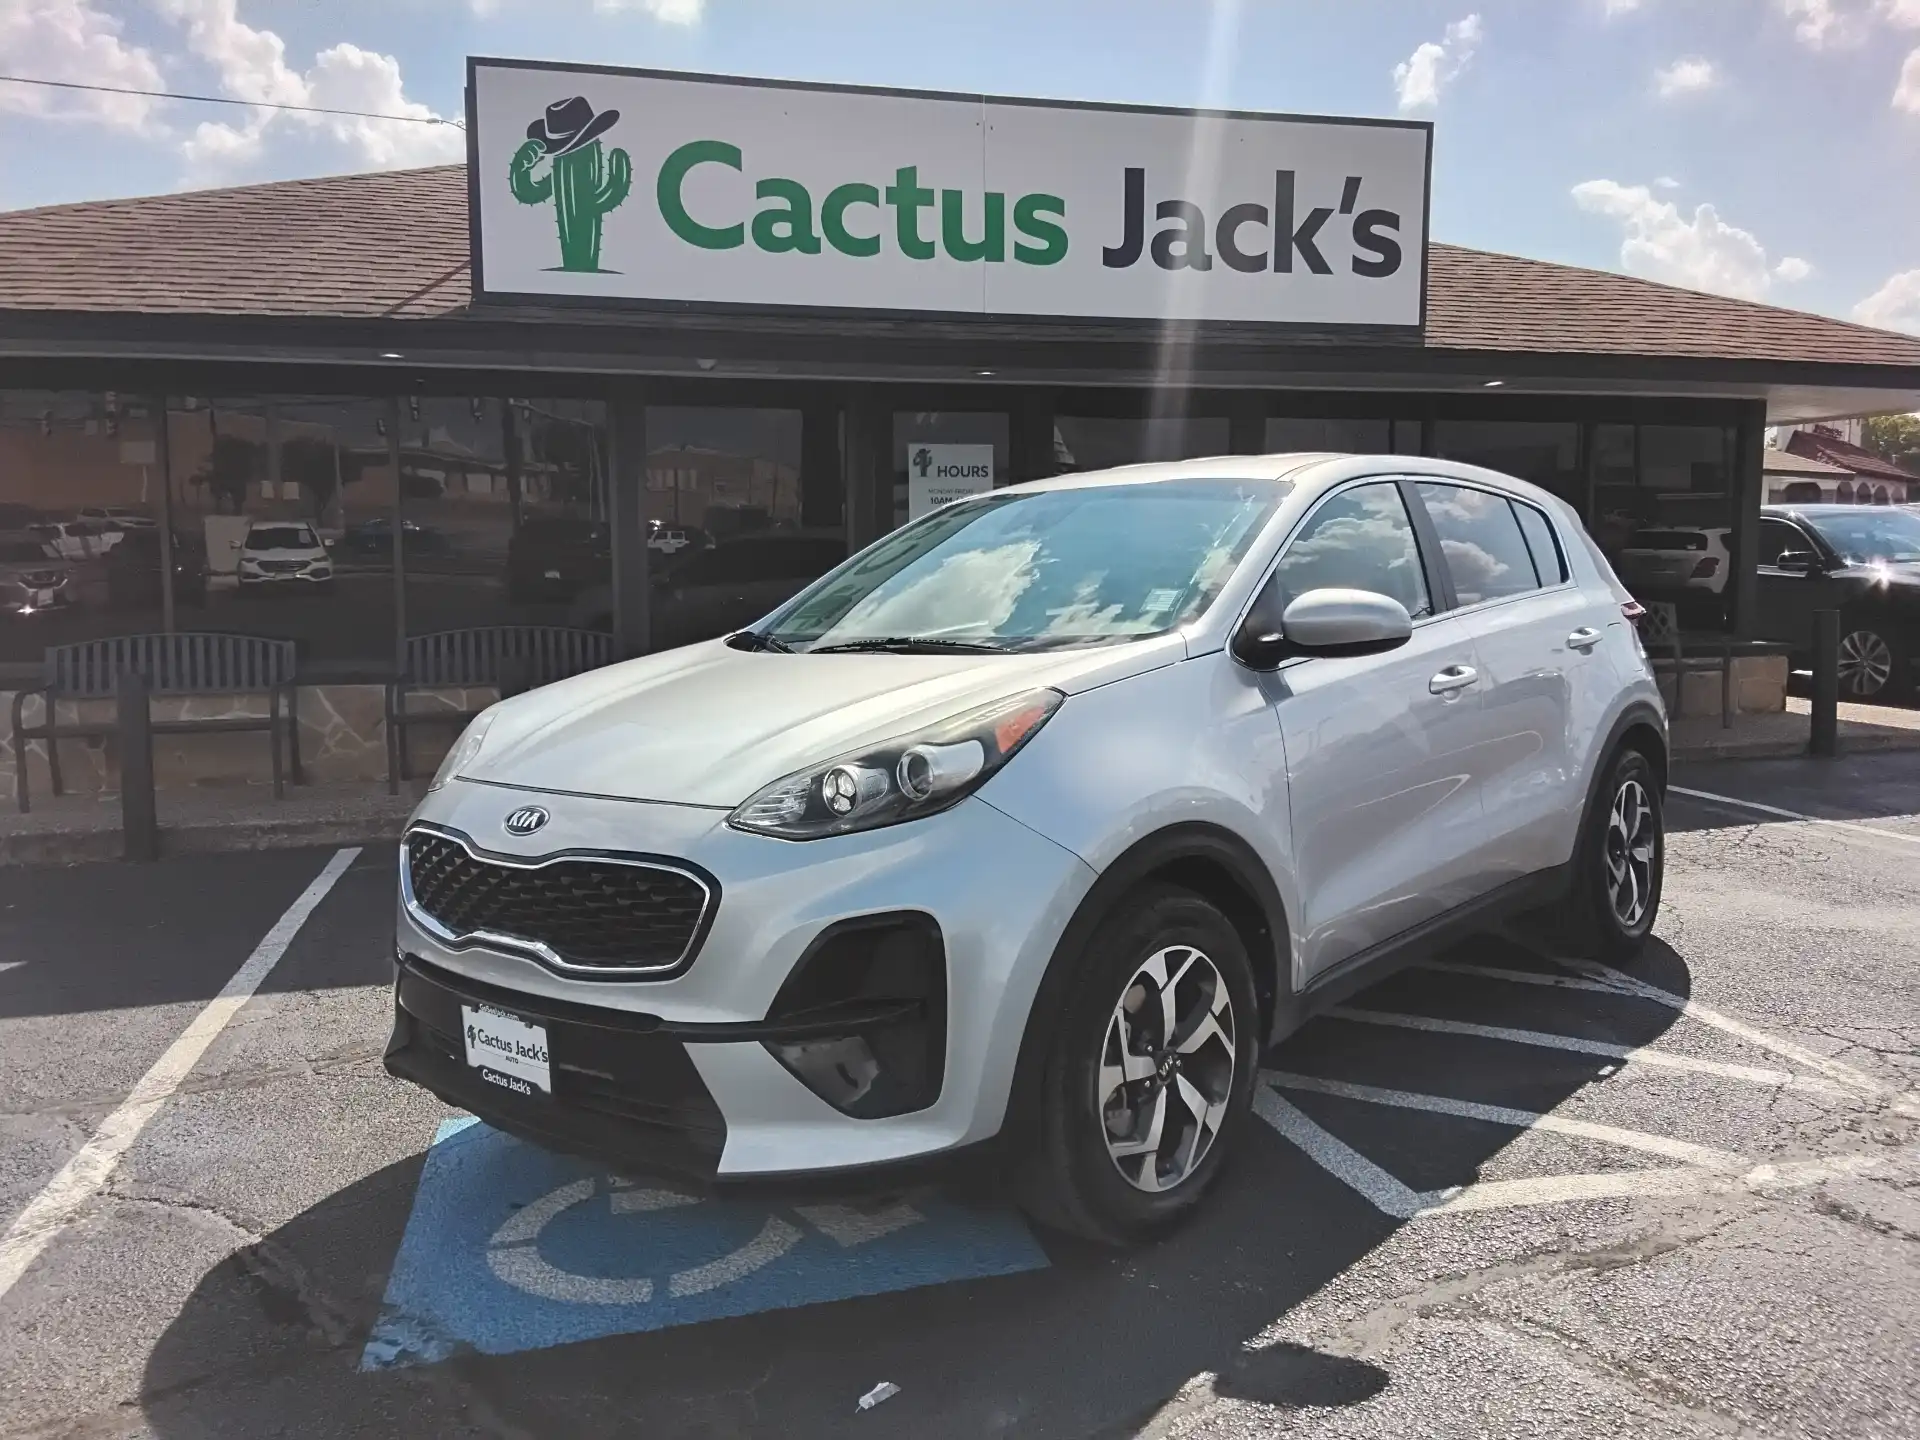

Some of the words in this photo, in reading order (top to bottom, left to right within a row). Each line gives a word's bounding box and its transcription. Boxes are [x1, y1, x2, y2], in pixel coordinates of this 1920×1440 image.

[656, 139, 1069, 266] Cactus
[1101, 167, 1402, 278] Jack's
[937, 465, 989, 478] HOURS
[508, 810, 541, 829] KIA
[477, 1028, 513, 1053] Cactus
[515, 1040, 549, 1063] Jack's
[482, 1068, 508, 1087] Cactus
[509, 1077, 531, 1095] Jack's
